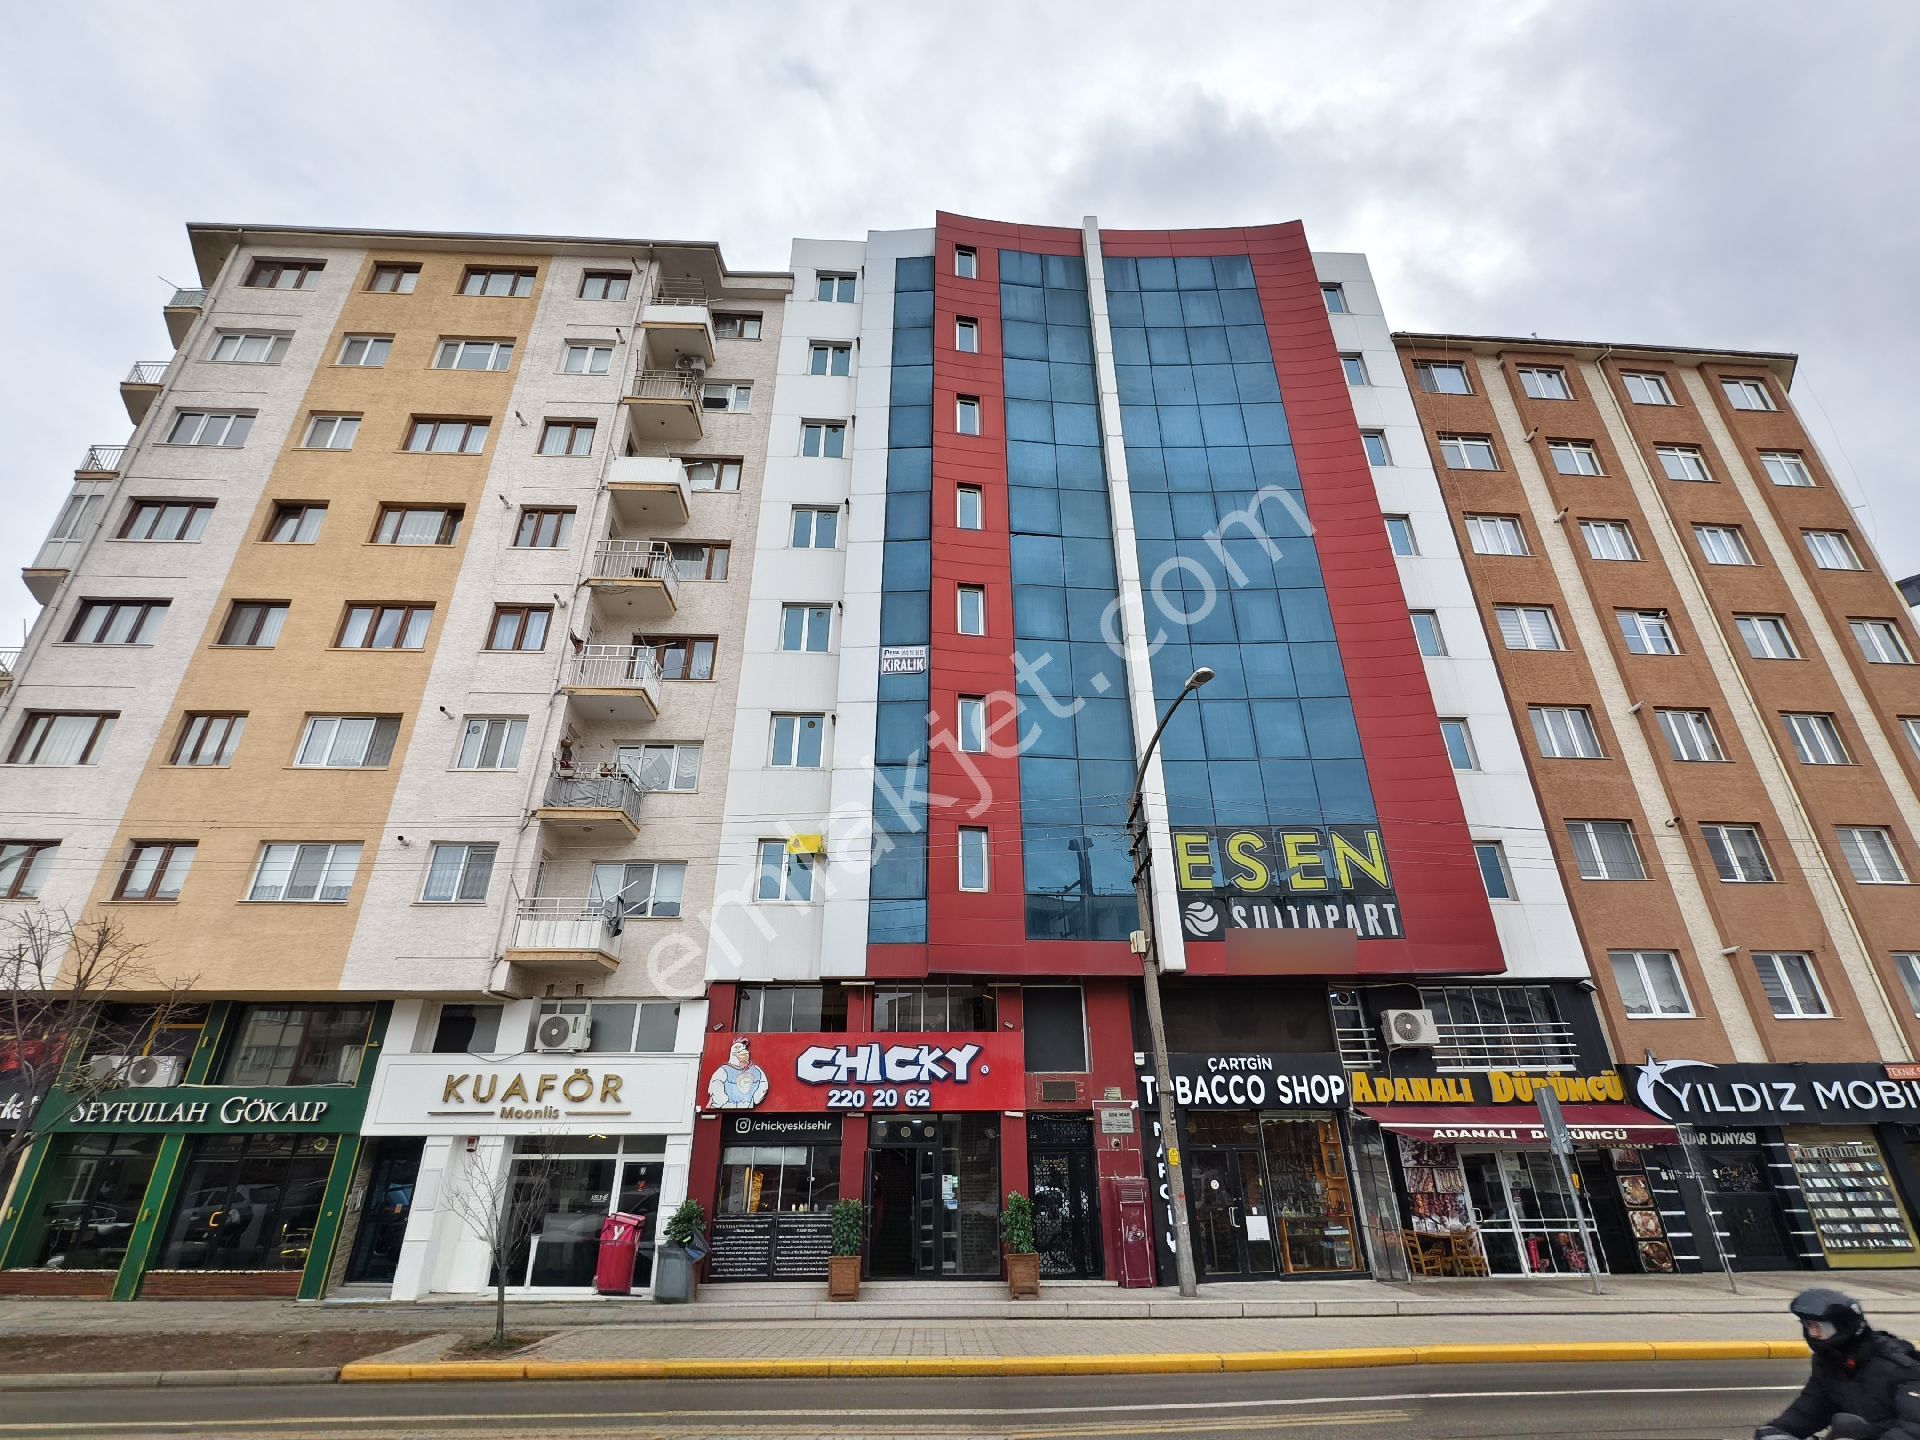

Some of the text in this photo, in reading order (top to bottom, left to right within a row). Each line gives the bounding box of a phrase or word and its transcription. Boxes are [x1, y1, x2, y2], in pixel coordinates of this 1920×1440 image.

[1173, 831, 1392, 892] ESEN
[796, 1042, 982, 1085] CHICKY
[1207, 1054, 1273, 1073] ÇARTGİN
[442, 1068, 624, 1103] KUAFÖR
[827, 1089, 931, 1108] 220 20 62
[1276, 1074, 1345, 1105] SHOP
[1351, 1071, 1475, 1103] ADANALI
[1665, 1081, 1805, 1113] YILDIZ
[69, 1096, 328, 1124] SEYFULLAH GÖKALP
[1433, 1129, 1518, 1139] ADANALI
[1711, 1132, 1757, 1145] DÜNYASI
